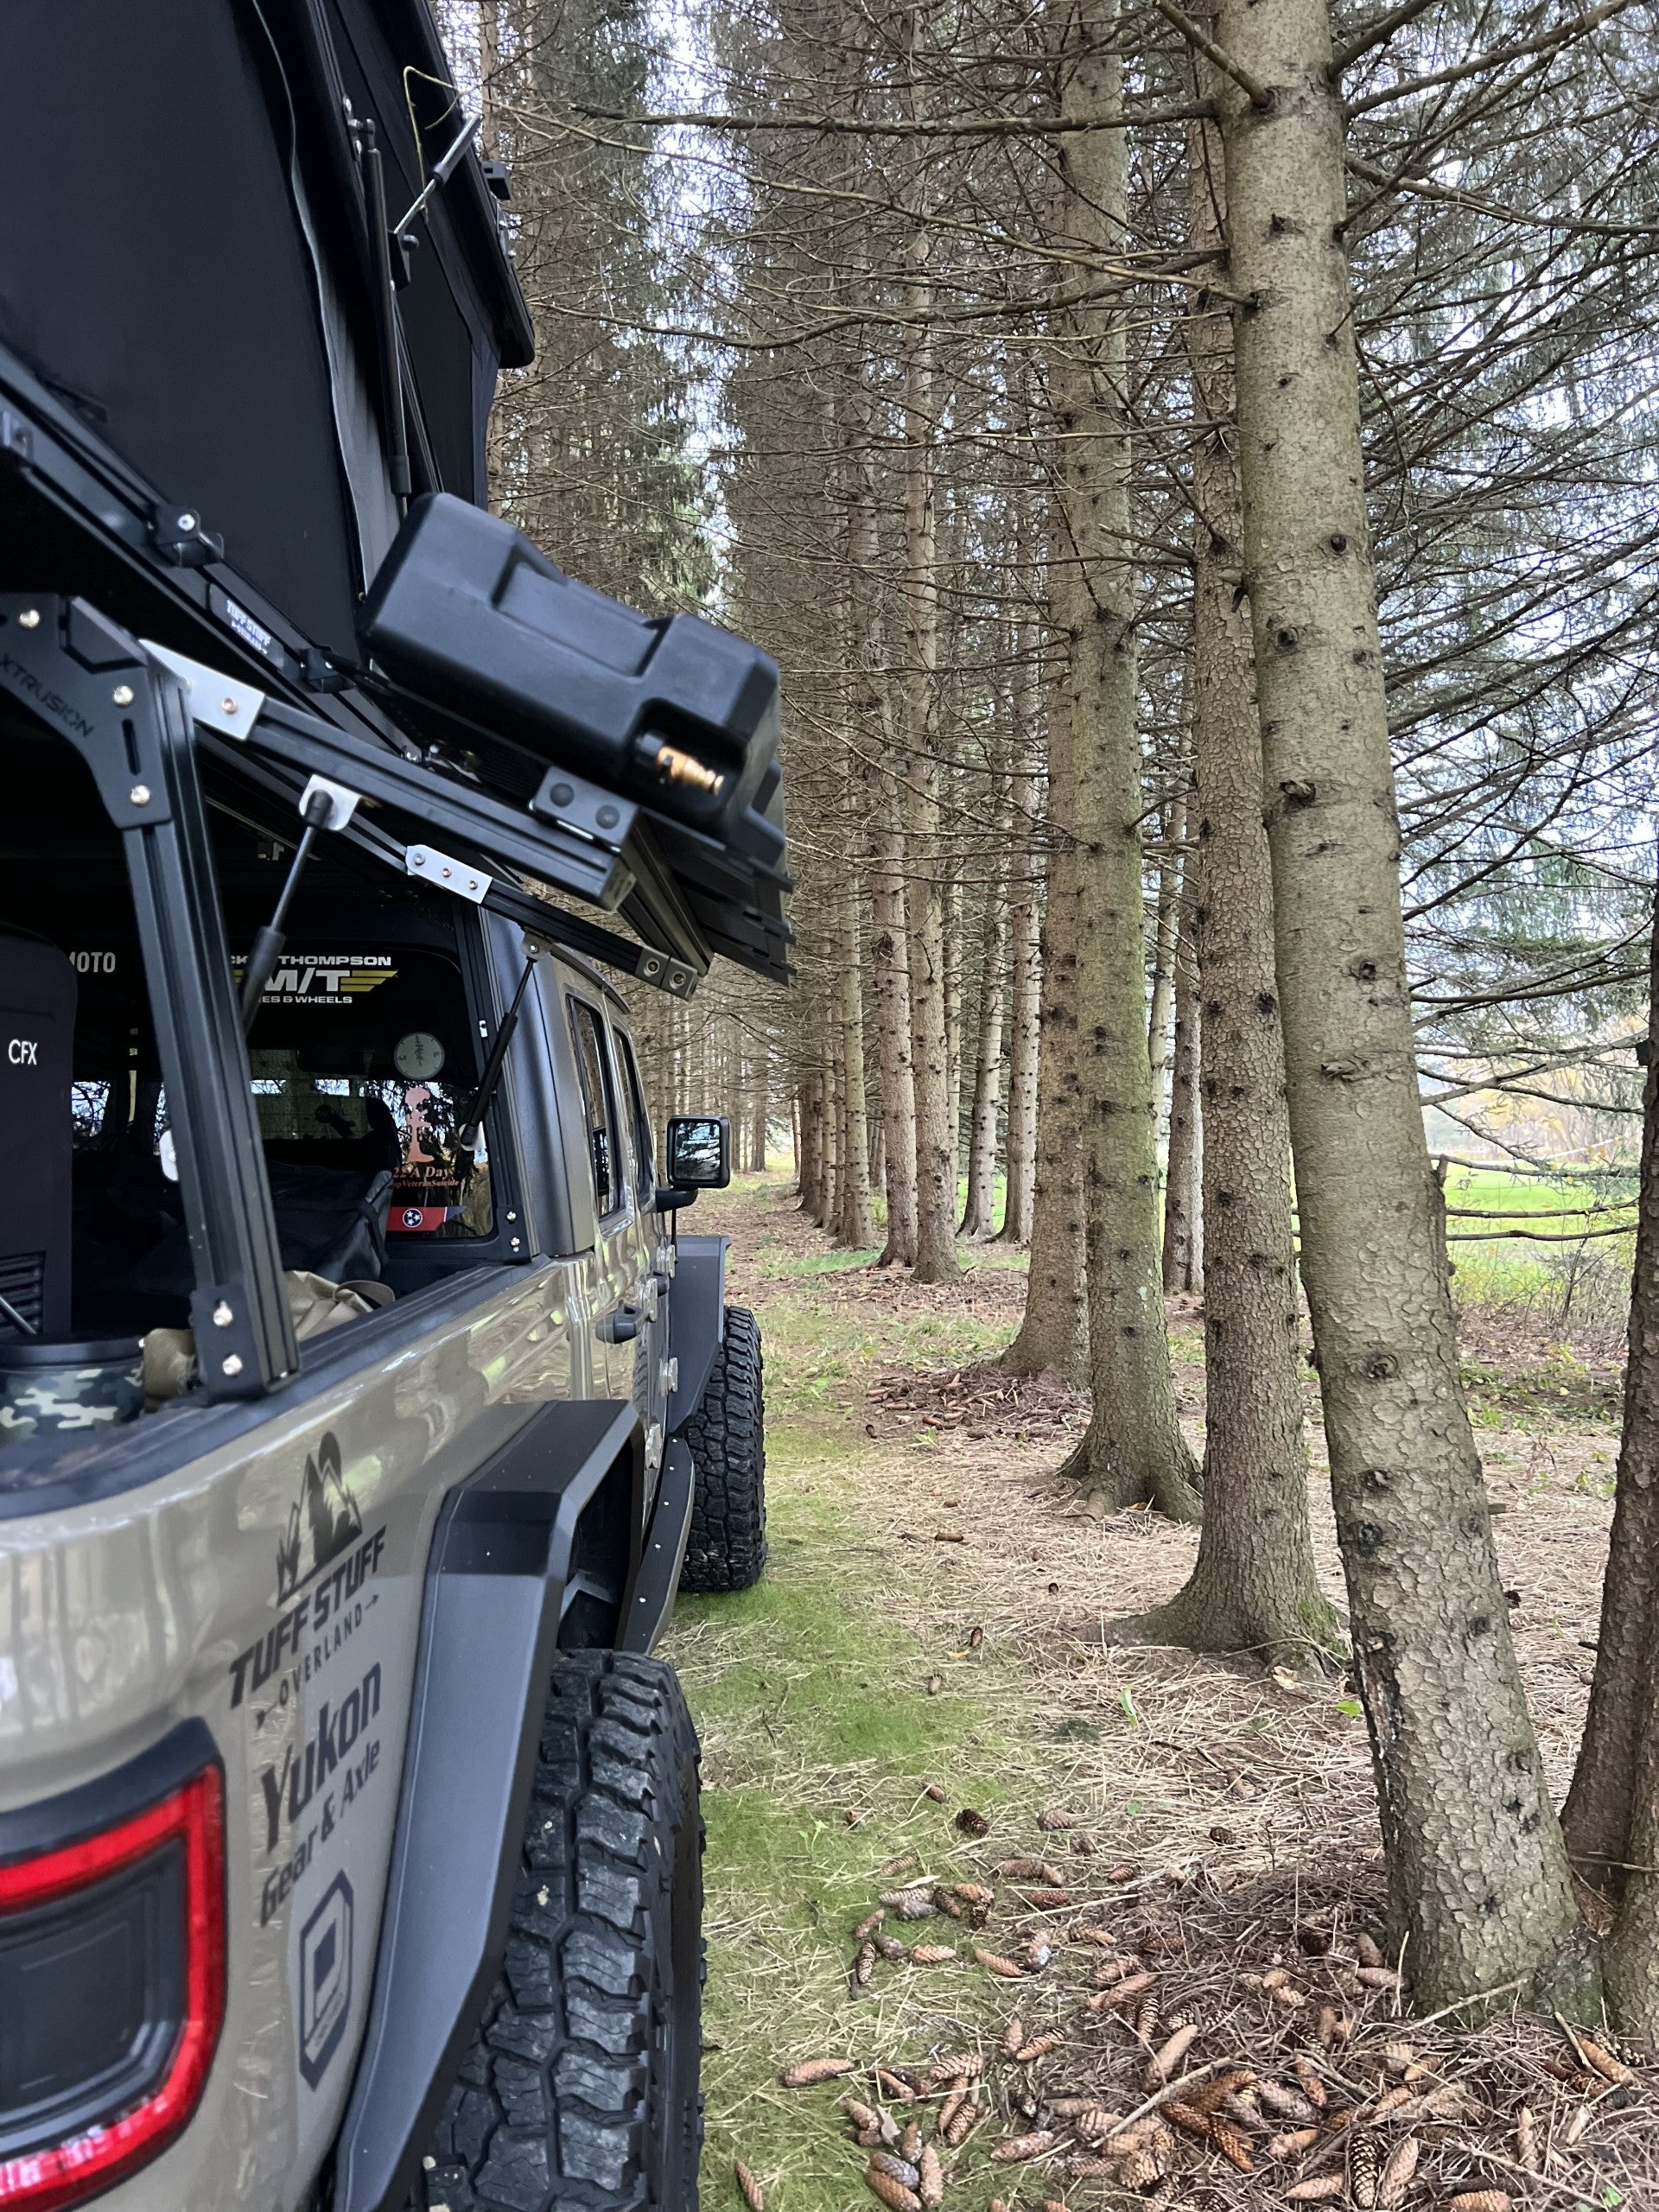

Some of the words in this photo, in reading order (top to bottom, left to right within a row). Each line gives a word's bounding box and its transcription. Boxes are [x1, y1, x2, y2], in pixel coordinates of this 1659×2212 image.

[277, 955, 391, 966] THOMPSON
[264, 967, 350, 994] M/T
[295, 995, 353, 1004] WHEELS
[8, 1039, 38, 1065] CFX
[410, 1166, 421, 1178] A
[229, 1594, 311, 1710] TUFF
[313, 1524, 387, 1632] STUFF
[279, 1602, 363, 1707] OVERLAND
[261, 1661, 382, 1855] Yukon
[260, 1823, 318, 1929] Gear
[320, 1790, 336, 1845] &
[340, 1739, 381, 1820] Axle
